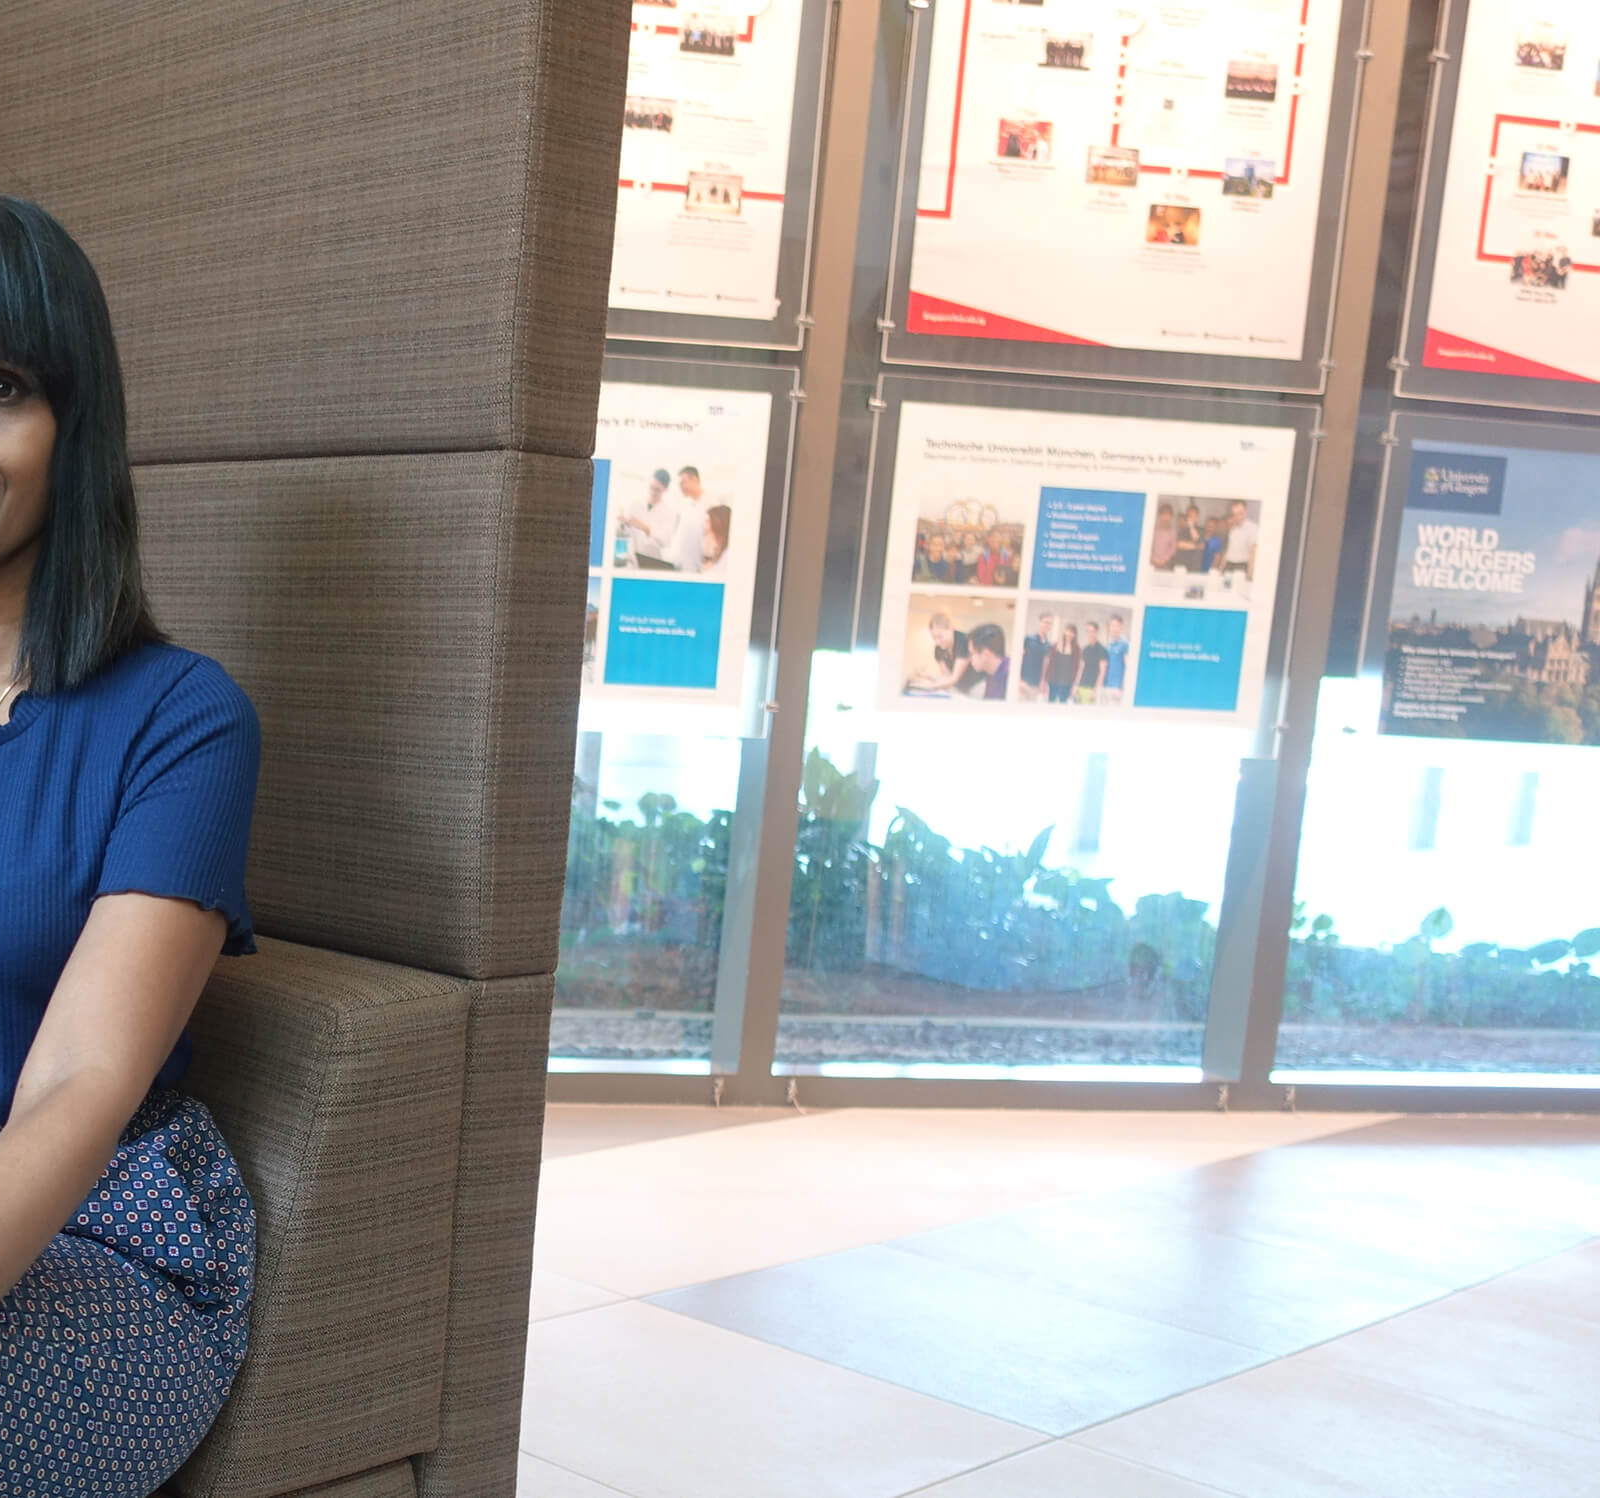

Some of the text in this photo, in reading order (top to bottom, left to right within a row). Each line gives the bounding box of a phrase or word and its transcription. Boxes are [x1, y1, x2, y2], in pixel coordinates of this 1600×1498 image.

[925, 438, 984, 451] Technische
[1417, 523, 1500, 550] WORLD
[1414, 546, 1537, 576] CHANGERS
[1411, 565, 1525, 594] WELCOME
